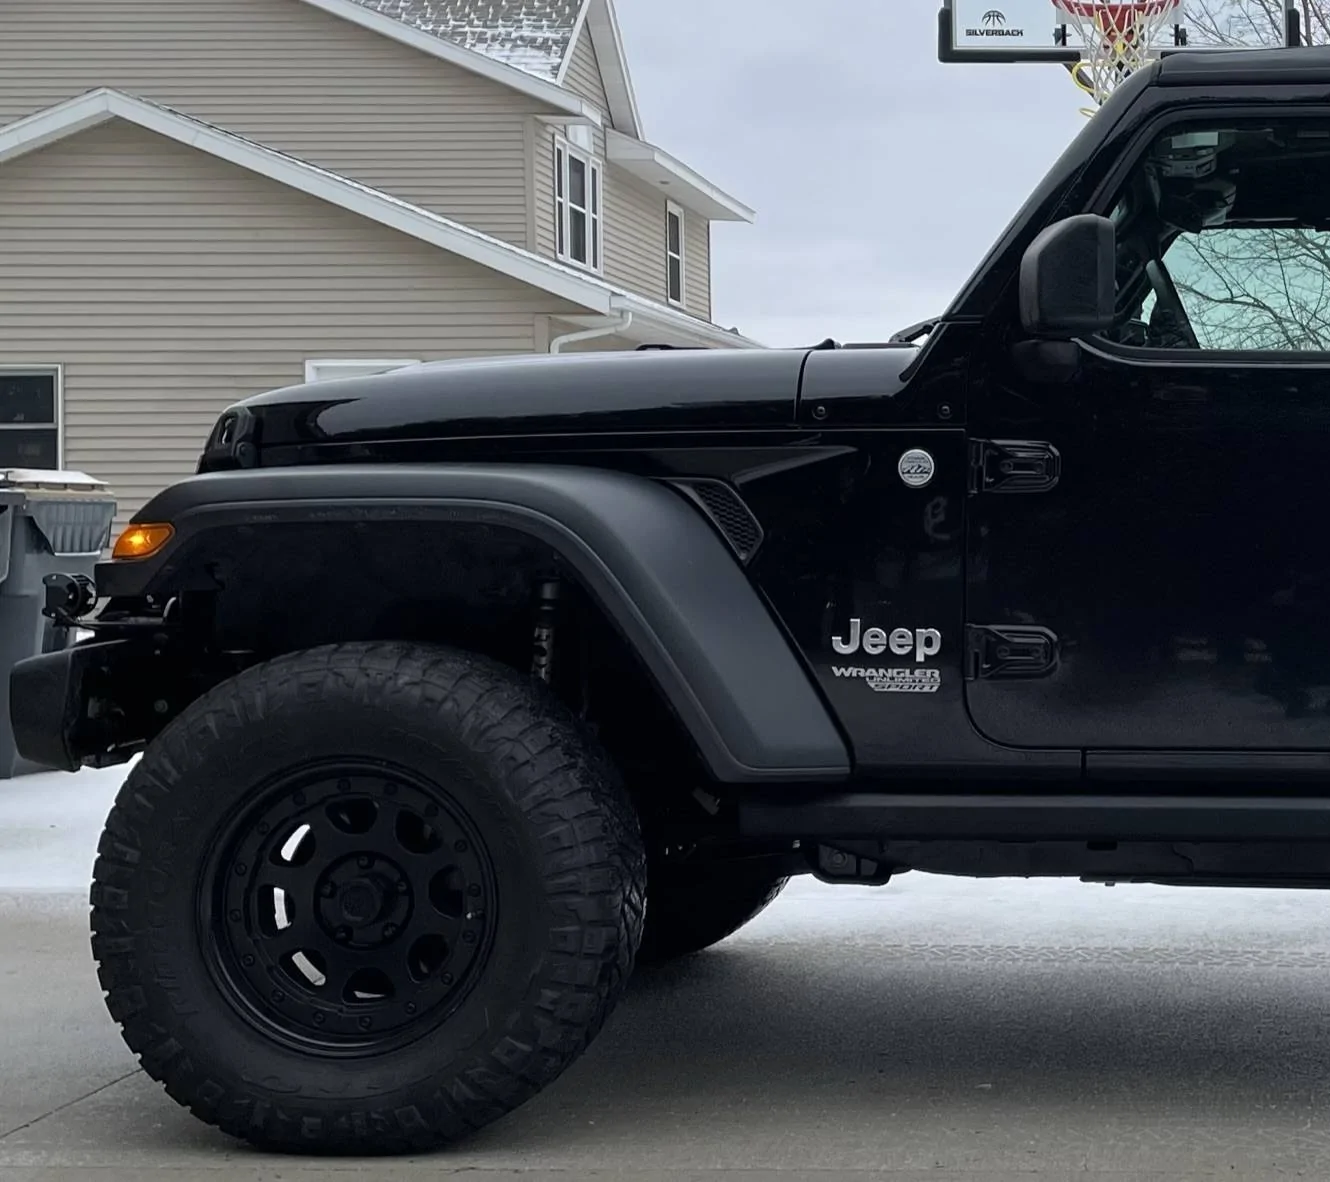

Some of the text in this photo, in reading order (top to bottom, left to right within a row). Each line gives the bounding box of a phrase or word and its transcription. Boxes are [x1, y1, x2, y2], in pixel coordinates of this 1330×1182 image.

[831, 618, 942, 662] Jeep
[831, 666, 941, 678] WRANGLER
[871, 683, 939, 691] SPORT
